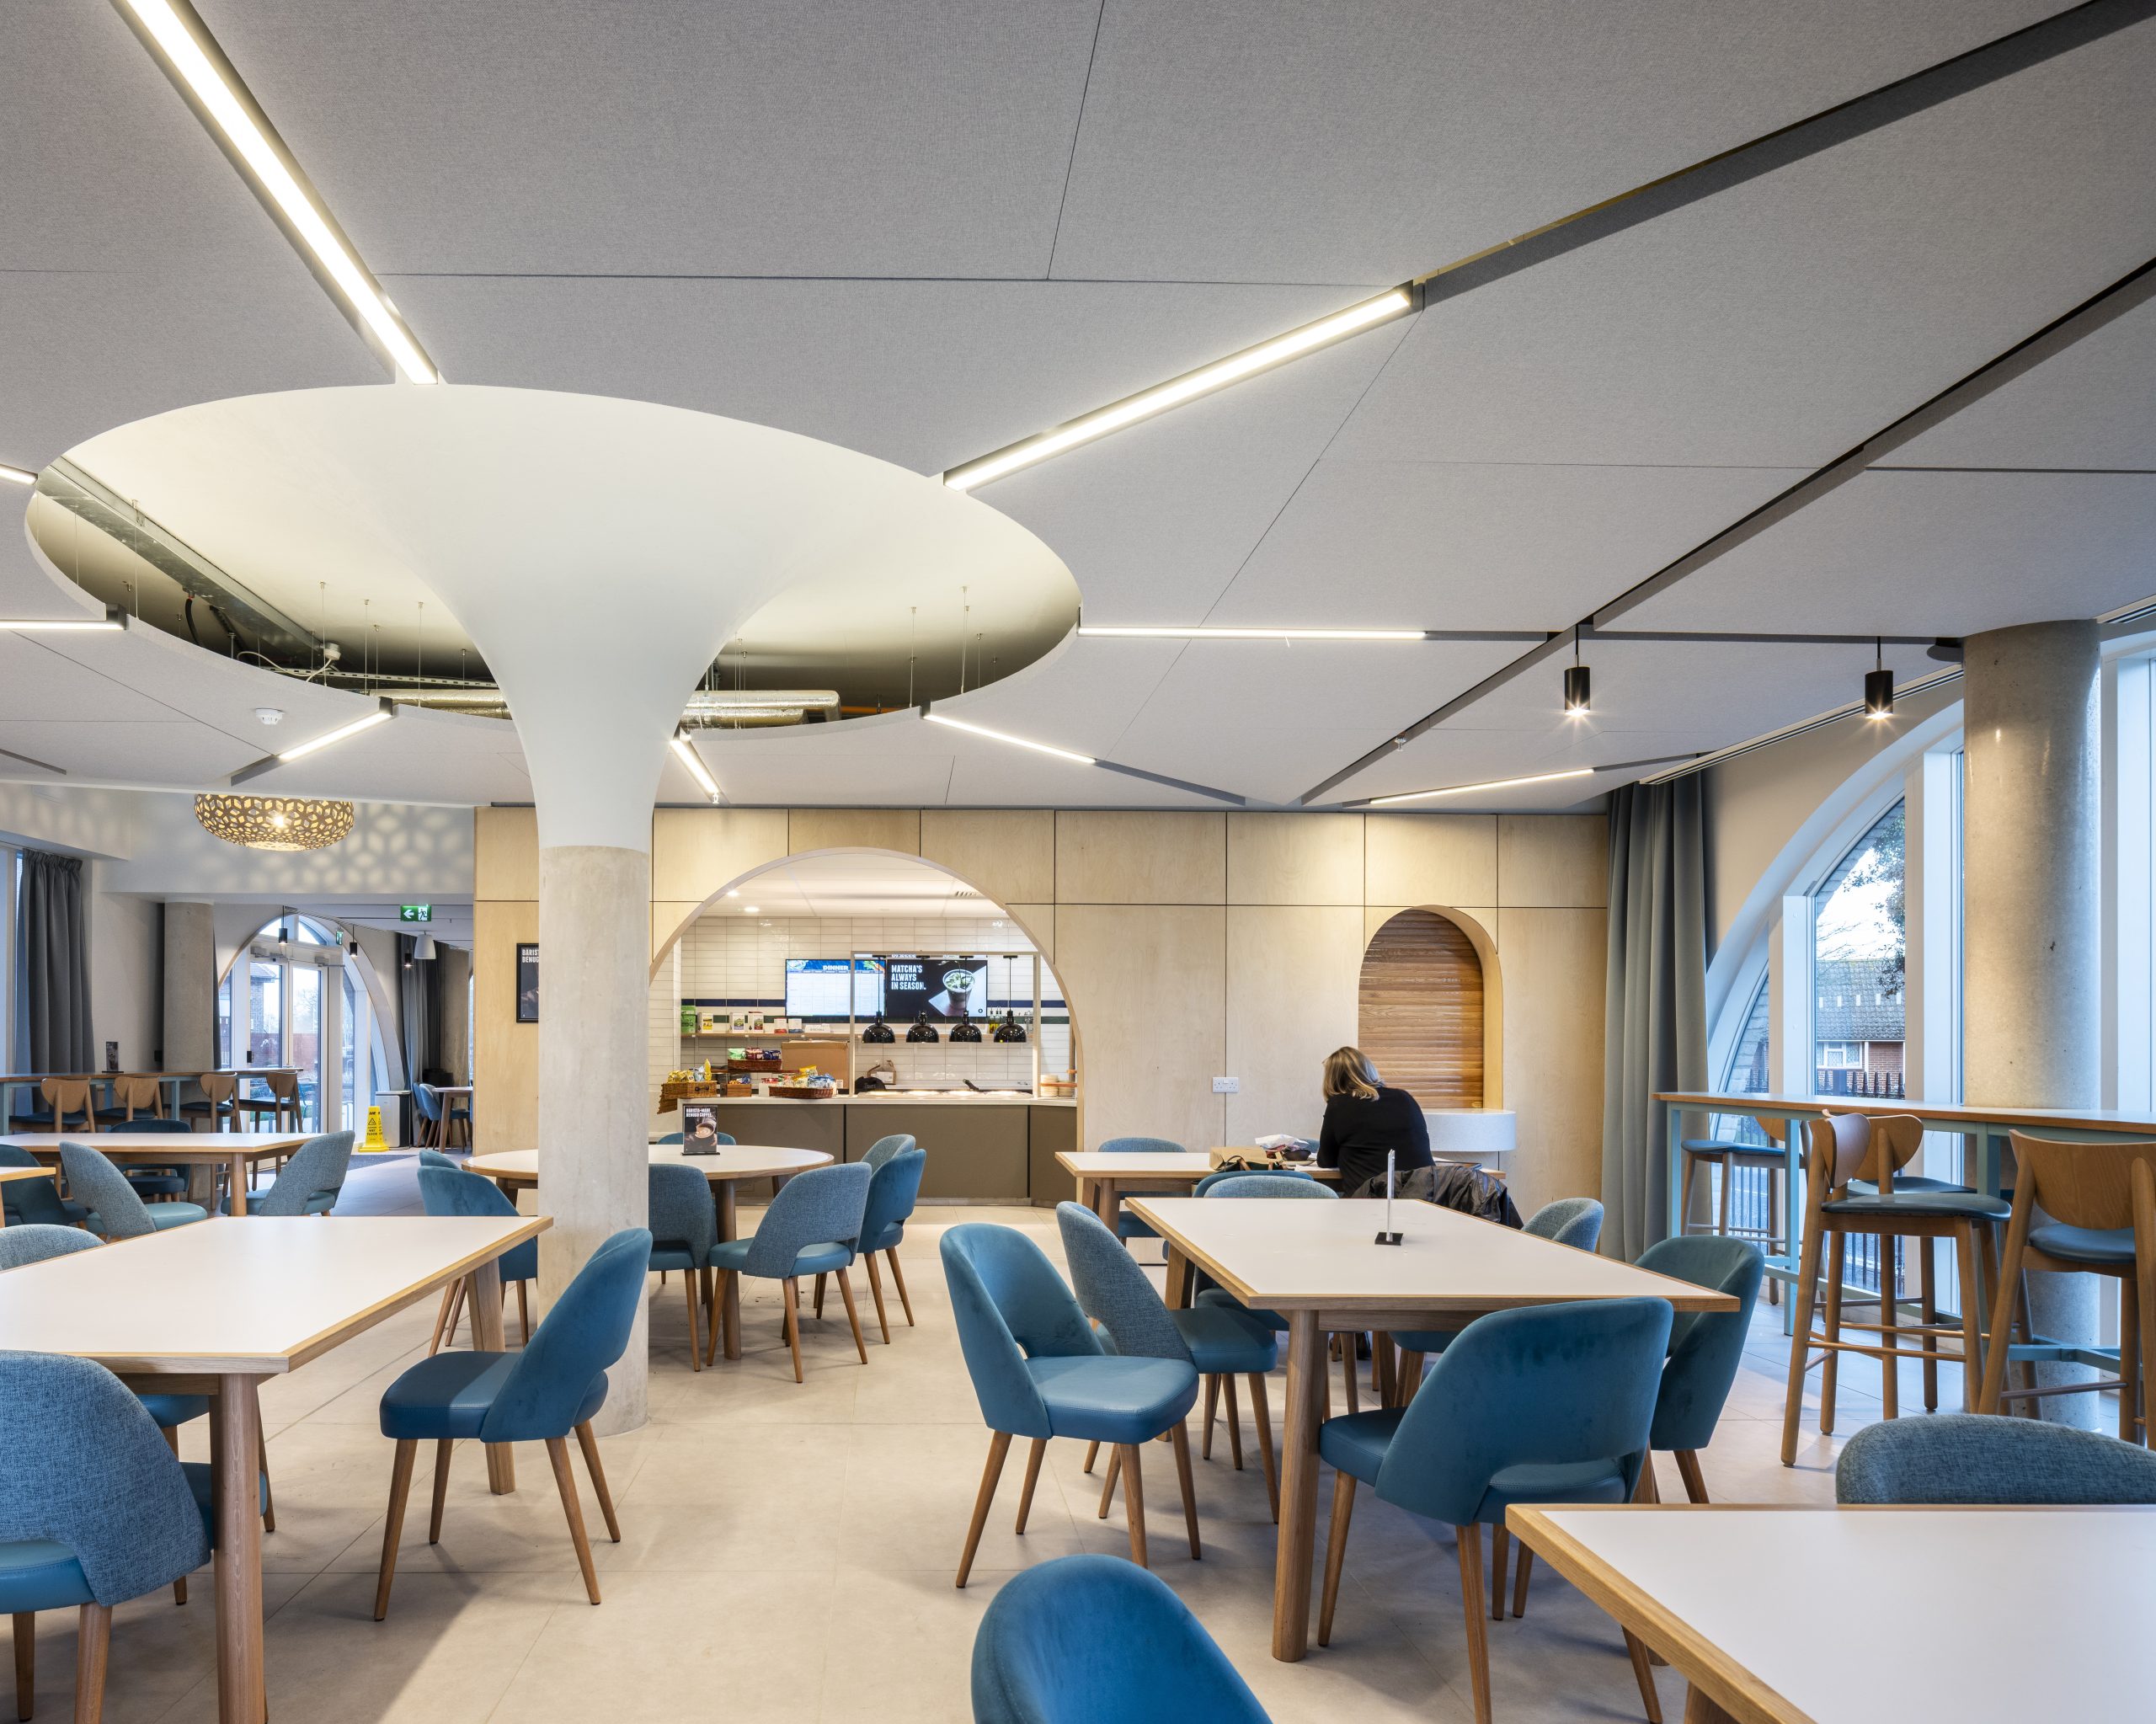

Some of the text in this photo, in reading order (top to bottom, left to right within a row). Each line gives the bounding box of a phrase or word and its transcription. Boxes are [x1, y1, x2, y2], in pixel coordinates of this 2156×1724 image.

[891, 964, 923, 974] MATCHA'S
[891, 973, 917, 981] ALWAYS
[891, 981, 926, 990] IN SEASON.
